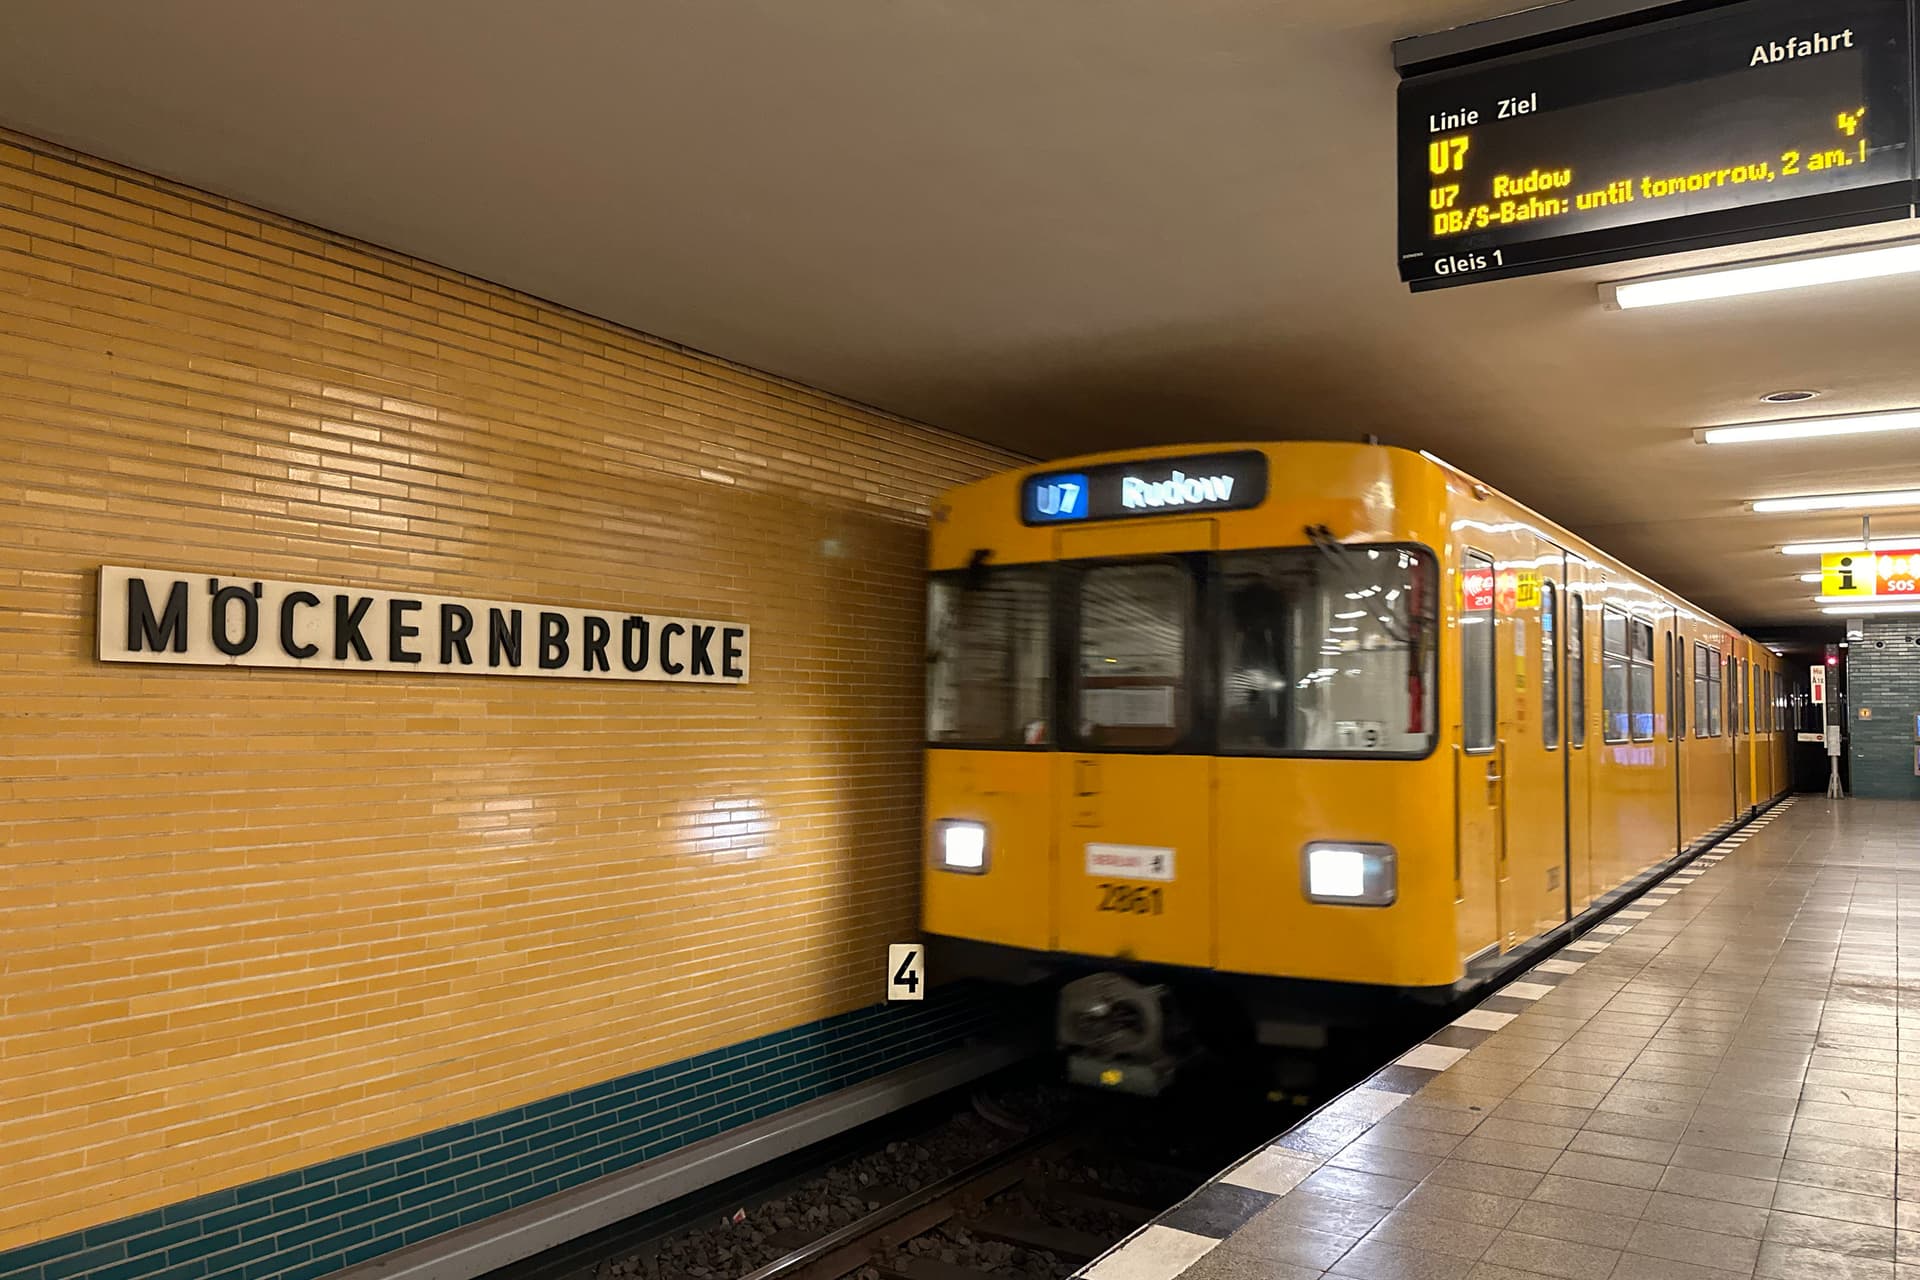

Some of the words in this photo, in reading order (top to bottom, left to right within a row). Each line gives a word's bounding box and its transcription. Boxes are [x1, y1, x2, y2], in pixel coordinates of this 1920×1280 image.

[1750, 28, 1854, 67] Abfahrt
[1430, 108, 1479, 132] Linie
[1497, 92, 1537, 119] Ziel
[1429, 135, 1469, 174] U7
[1429, 184, 1459, 209] U7
[1493, 168, 1571, 198] Rudow
[1433, 196, 1569, 235] DB/S-Bahn:
[1576, 180, 1634, 210] until
[1641, 163, 1774, 199] tomorrow,
[1781, 151, 1800, 176] 2
[1807, 147, 1853, 172] am.
[1434, 253, 1487, 275] Gleis
[1492, 249, 1503, 266] 1
[1037, 482, 1080, 515] U7
[1122, 470, 1234, 509] Rudow
[1887, 579, 1915, 592] SOS
[127, 577, 745, 678] MÖCKERNBRÜCKE
[894, 952, 919, 993] 4
